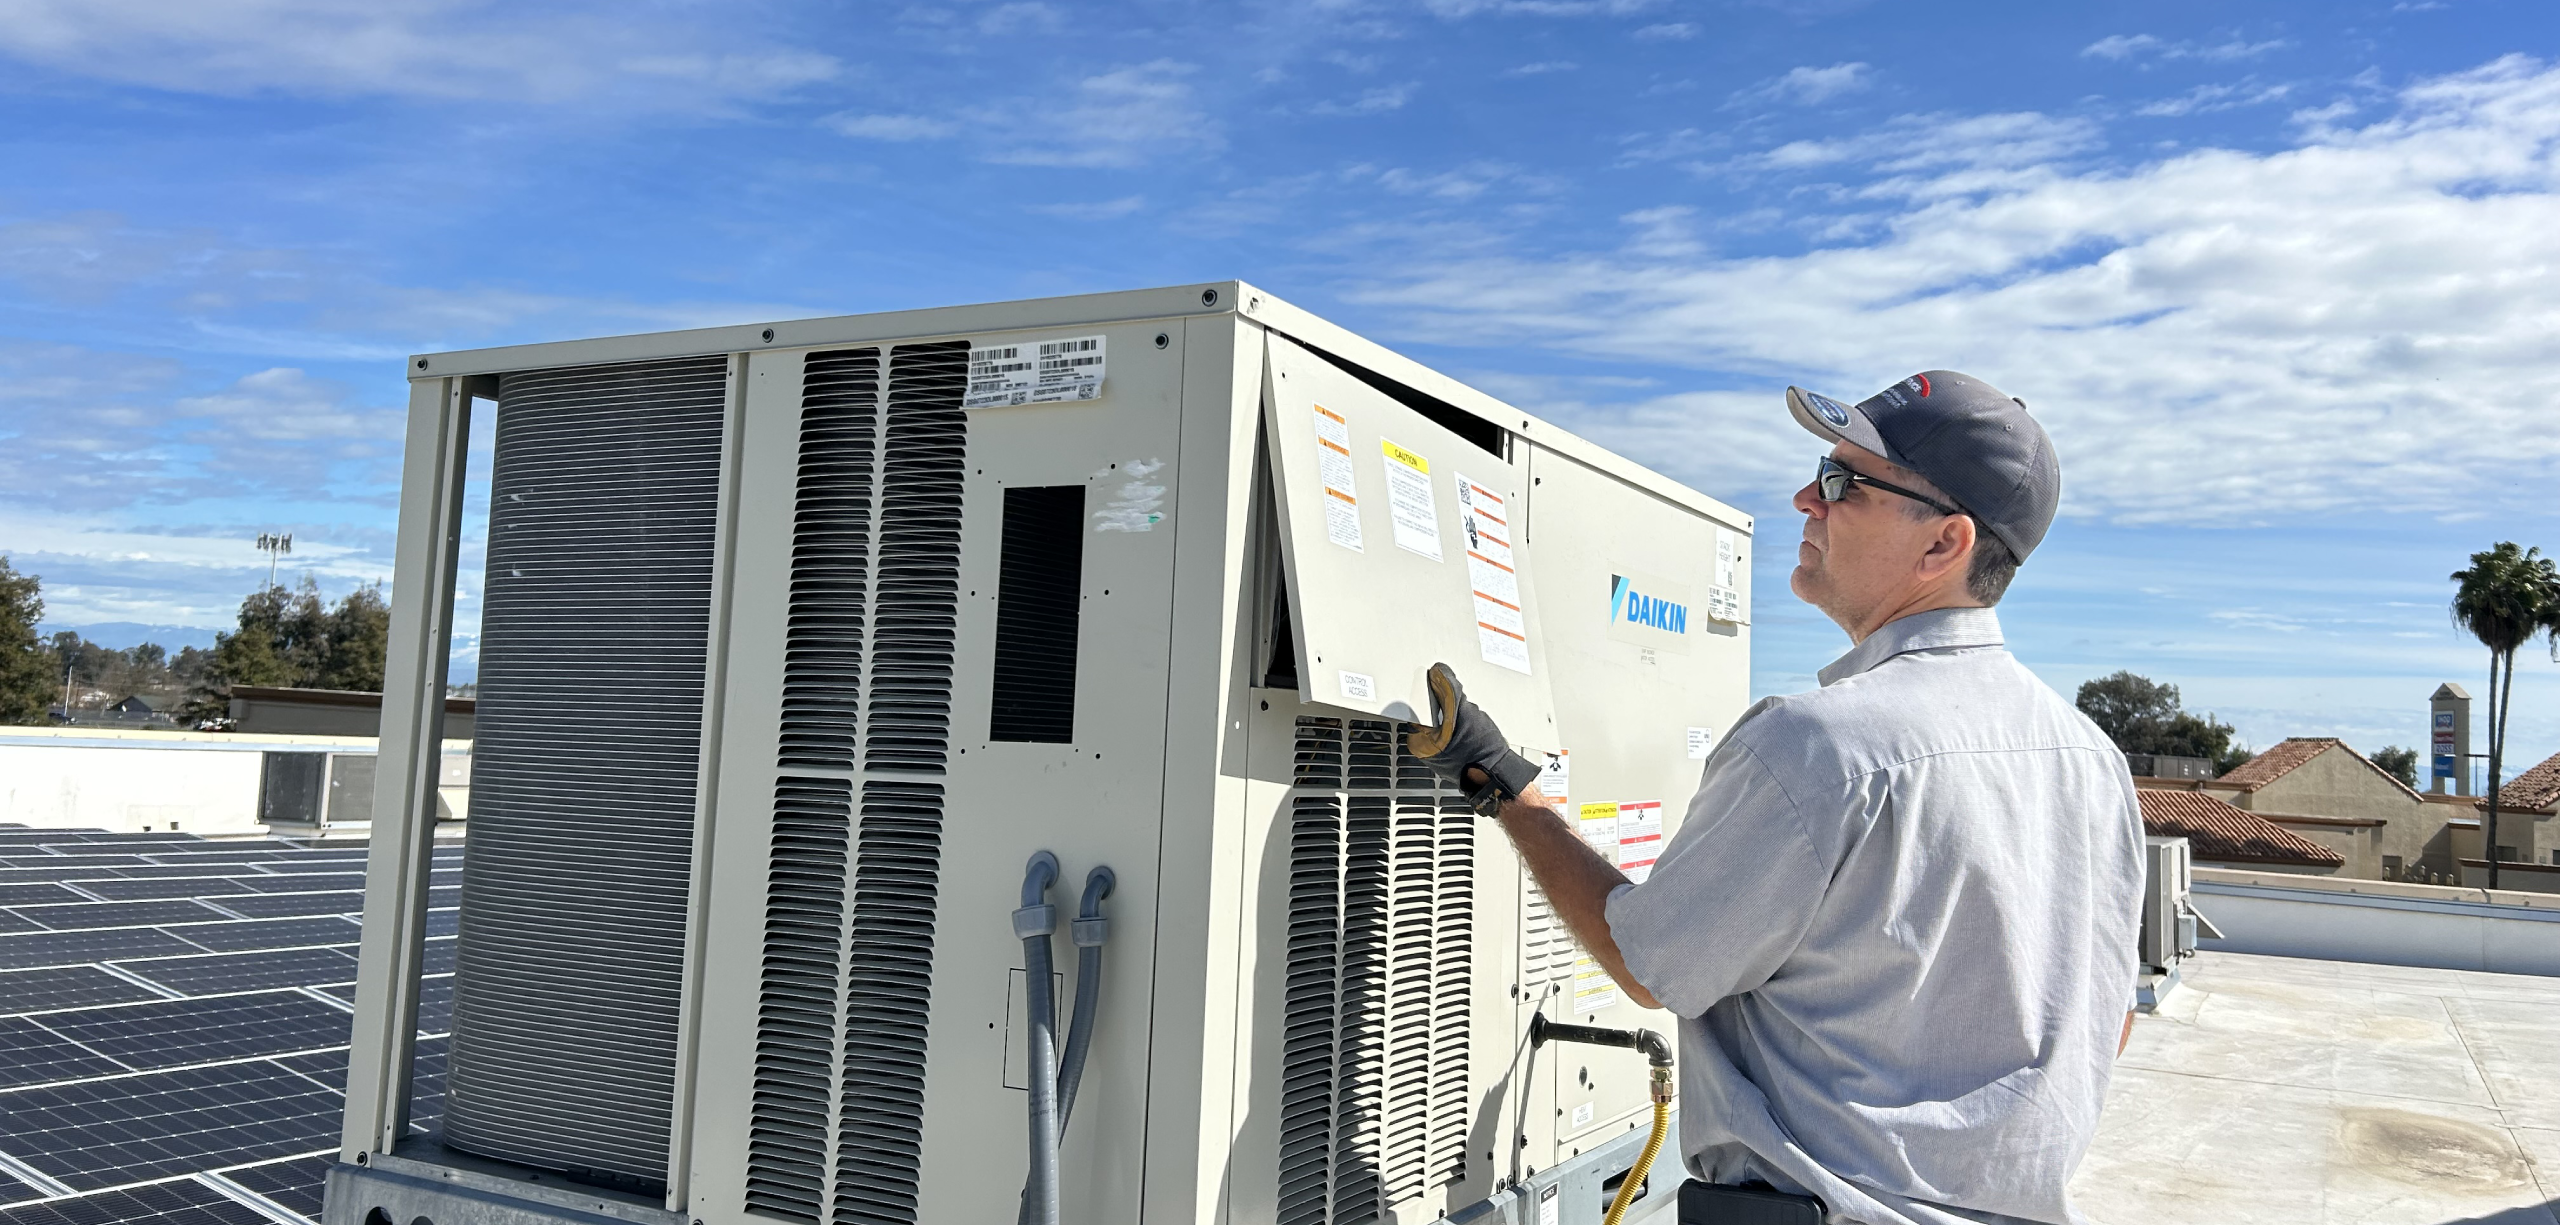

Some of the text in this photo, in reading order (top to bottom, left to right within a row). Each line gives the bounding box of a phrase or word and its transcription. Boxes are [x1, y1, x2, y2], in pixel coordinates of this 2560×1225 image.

[1394, 448, 1418, 467] CAUTION
[1627, 590, 1687, 634] DAIKIN
[1345, 674, 1369, 688] CONTROL
[1348, 686, 1369, 698] ACCESS
